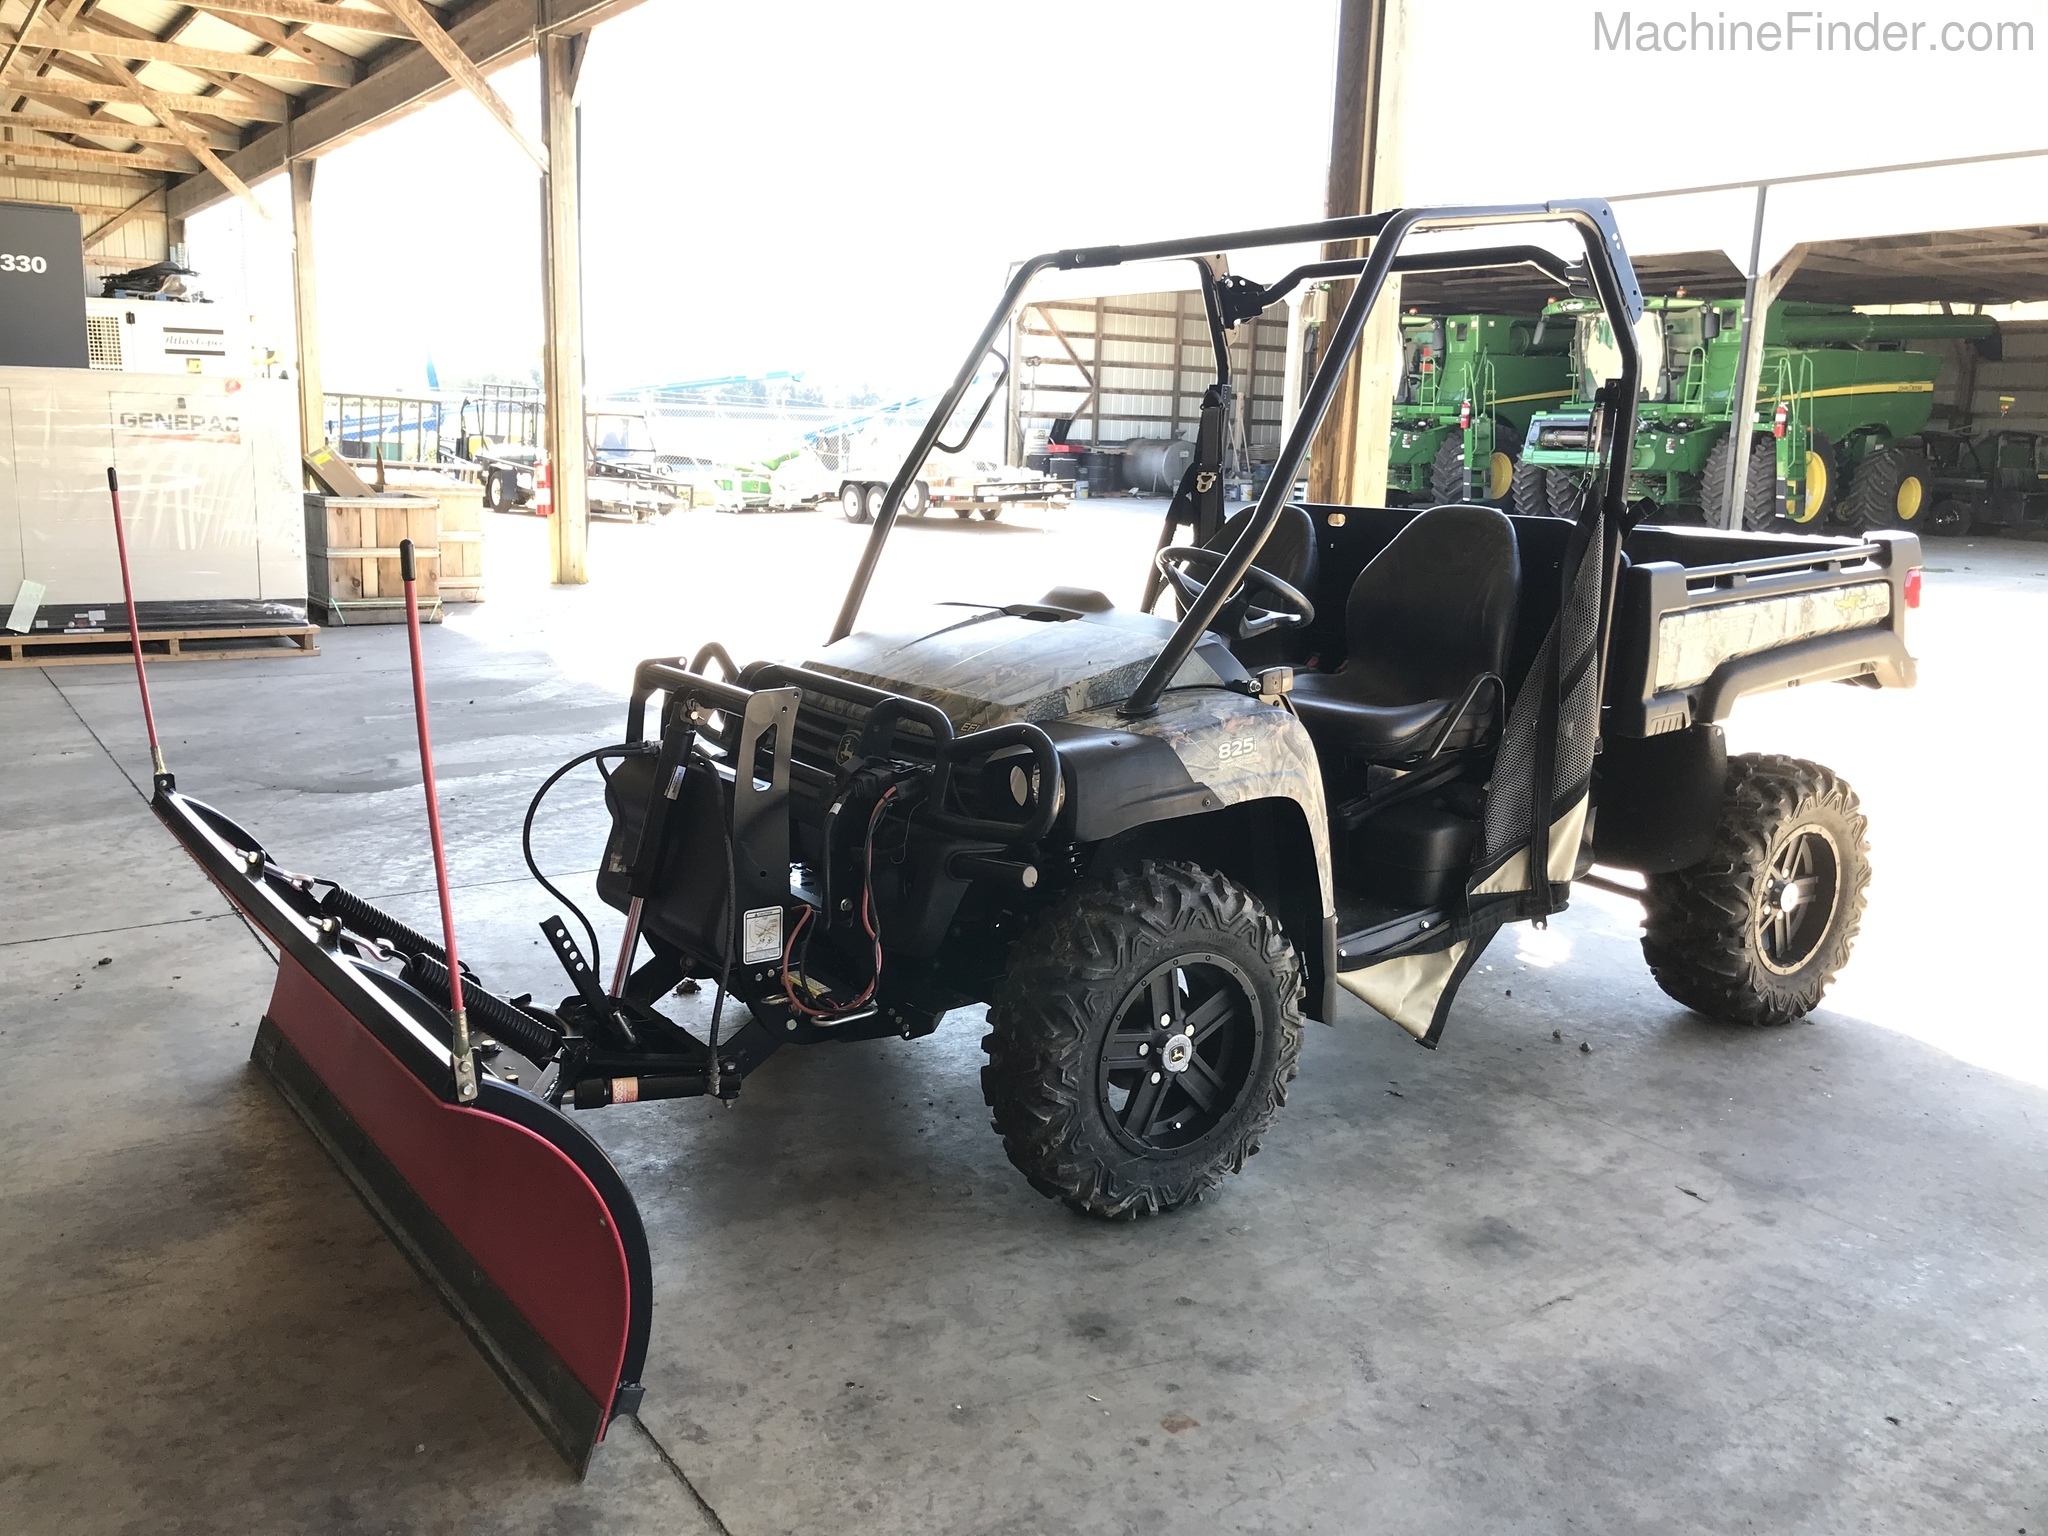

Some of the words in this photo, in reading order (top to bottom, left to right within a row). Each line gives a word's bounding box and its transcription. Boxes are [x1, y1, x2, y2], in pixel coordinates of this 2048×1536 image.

[0, 254, 47, 273] 330
[1671, 620, 1710, 643] JOHN
[1710, 614, 1754, 635] DEERE
[960, 722, 981, 733] EFI
[1218, 736, 1257, 760] 825i
[614, 1080, 624, 1103] BOSS
